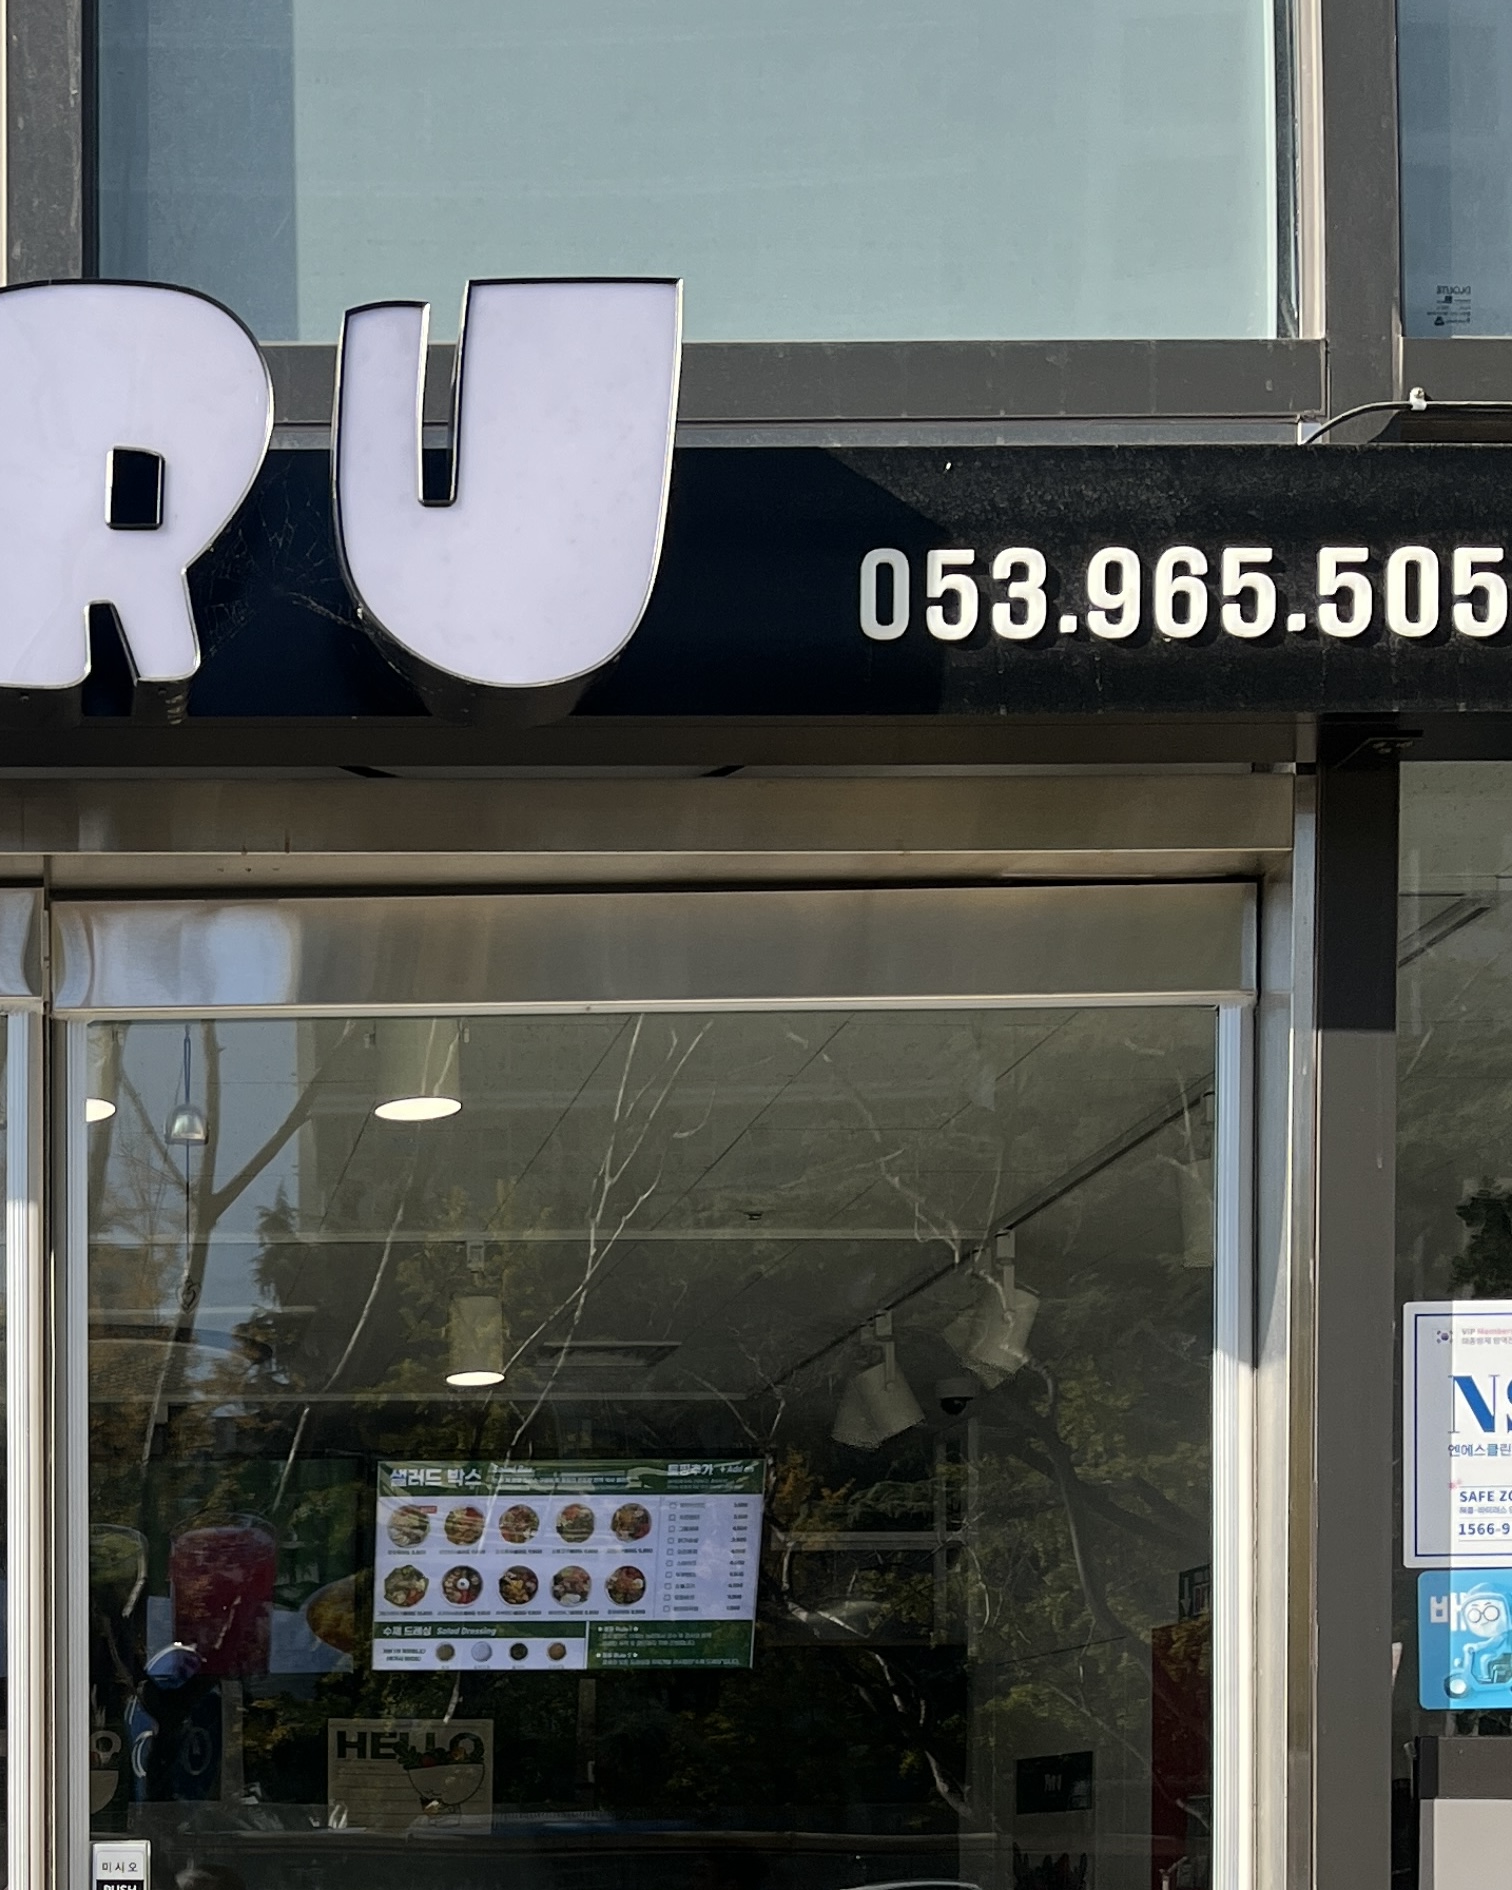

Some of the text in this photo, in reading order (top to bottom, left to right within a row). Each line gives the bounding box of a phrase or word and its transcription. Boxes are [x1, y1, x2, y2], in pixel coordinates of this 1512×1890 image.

[858, 544, 1509, 641] 053.965.505
[1447, 1374, 1512, 1434] N
[1459, 1490, 1495, 1503] SAFE
